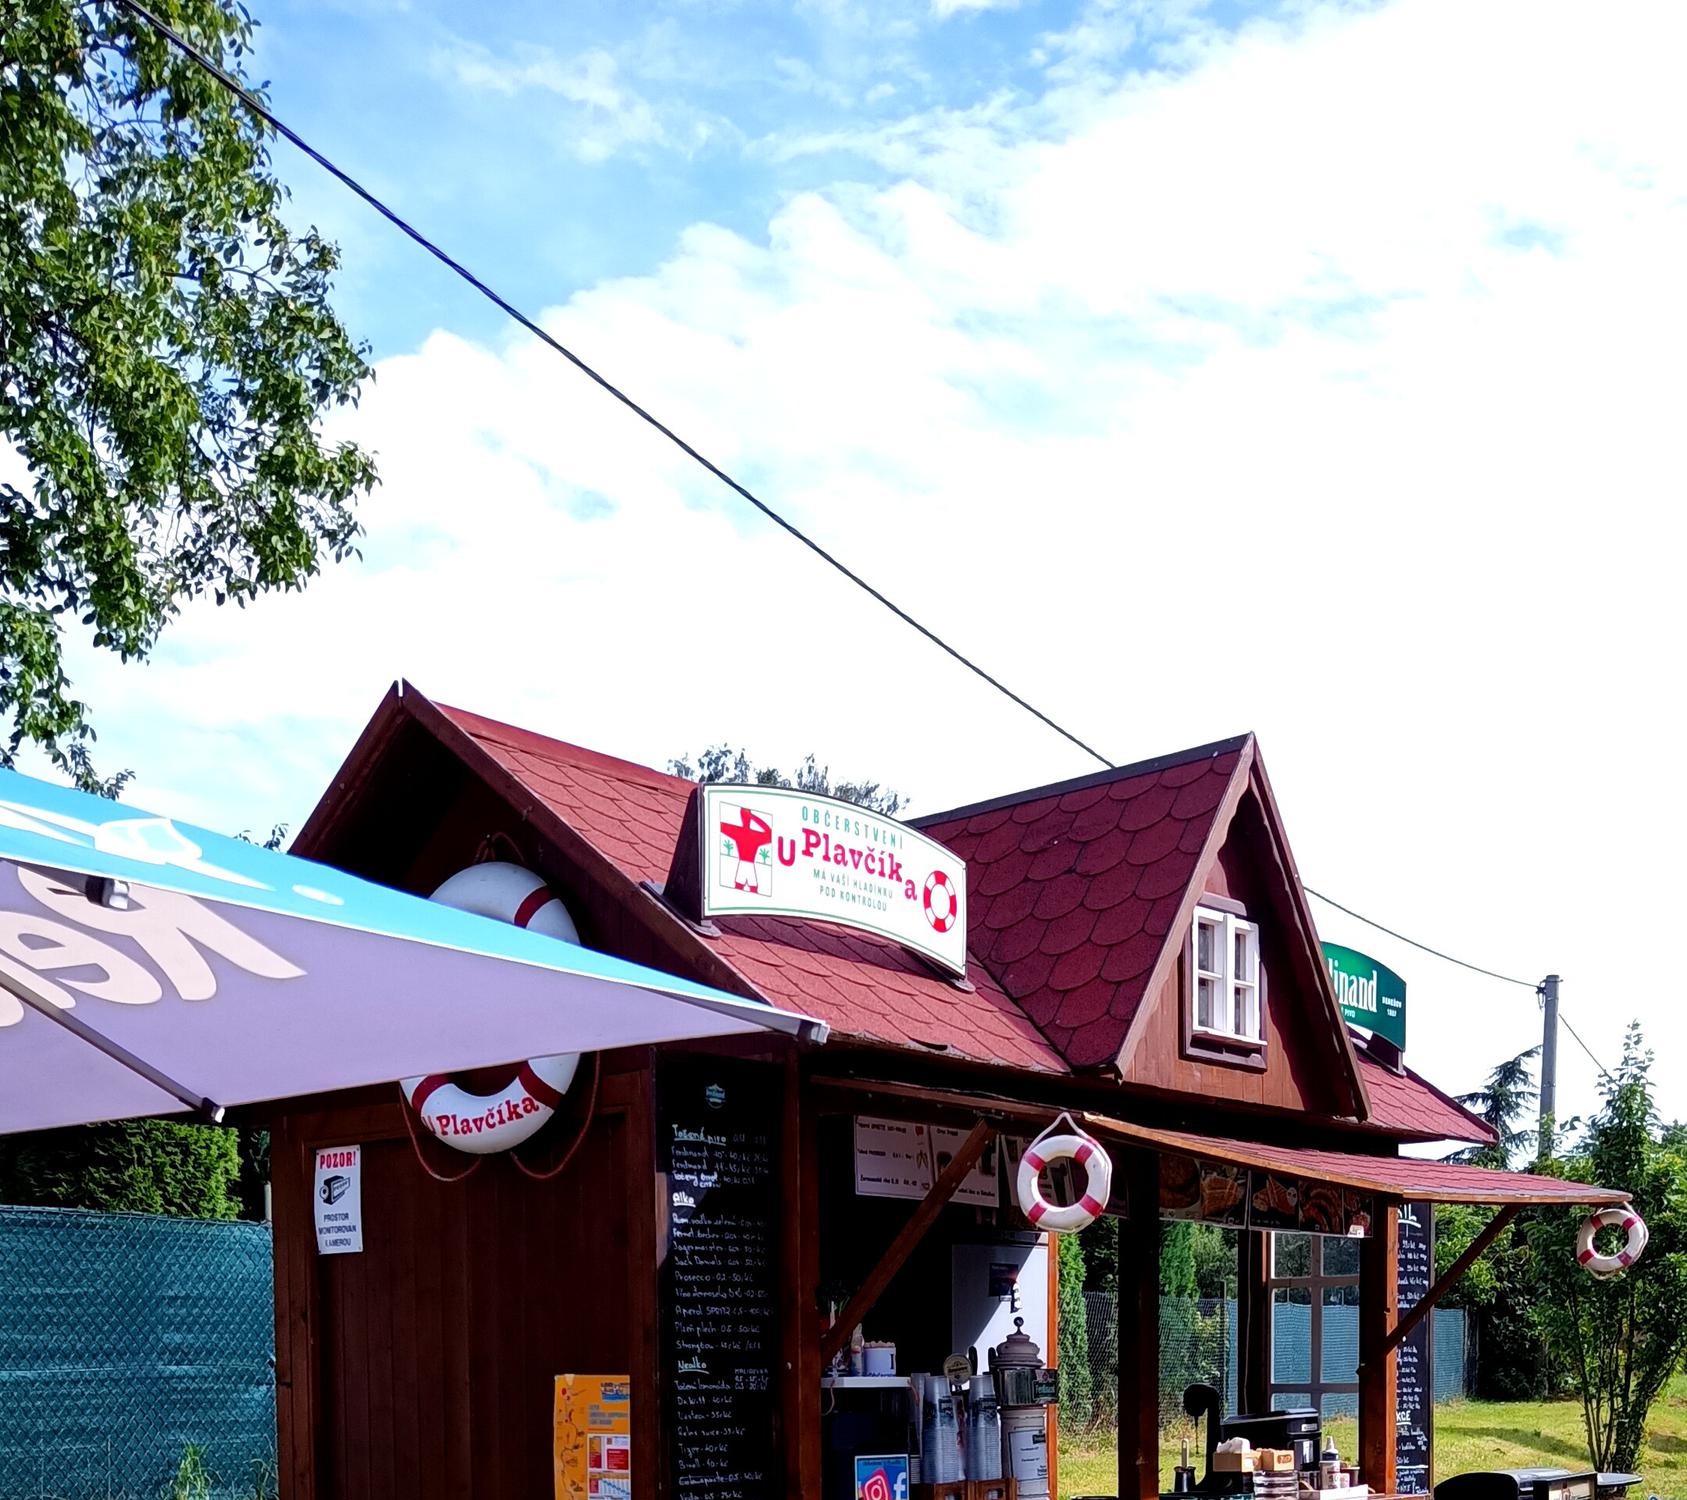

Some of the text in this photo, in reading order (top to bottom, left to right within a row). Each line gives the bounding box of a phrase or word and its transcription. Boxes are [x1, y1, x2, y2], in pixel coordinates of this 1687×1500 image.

[777, 828, 917, 901] U Plavčíka
[819, 885, 887, 912] POD KONTROLOU
[853, 879, 893, 899] HLADINKU
[436, 1096, 540, 1136] Plavčíka
[320, 1151, 356, 1169] POZOR!
[323, 1212, 350, 1223] PROSTOR
[675, 1270, 711, 1281] Prosecco
[677, 1355, 707, 1370] Nealko
